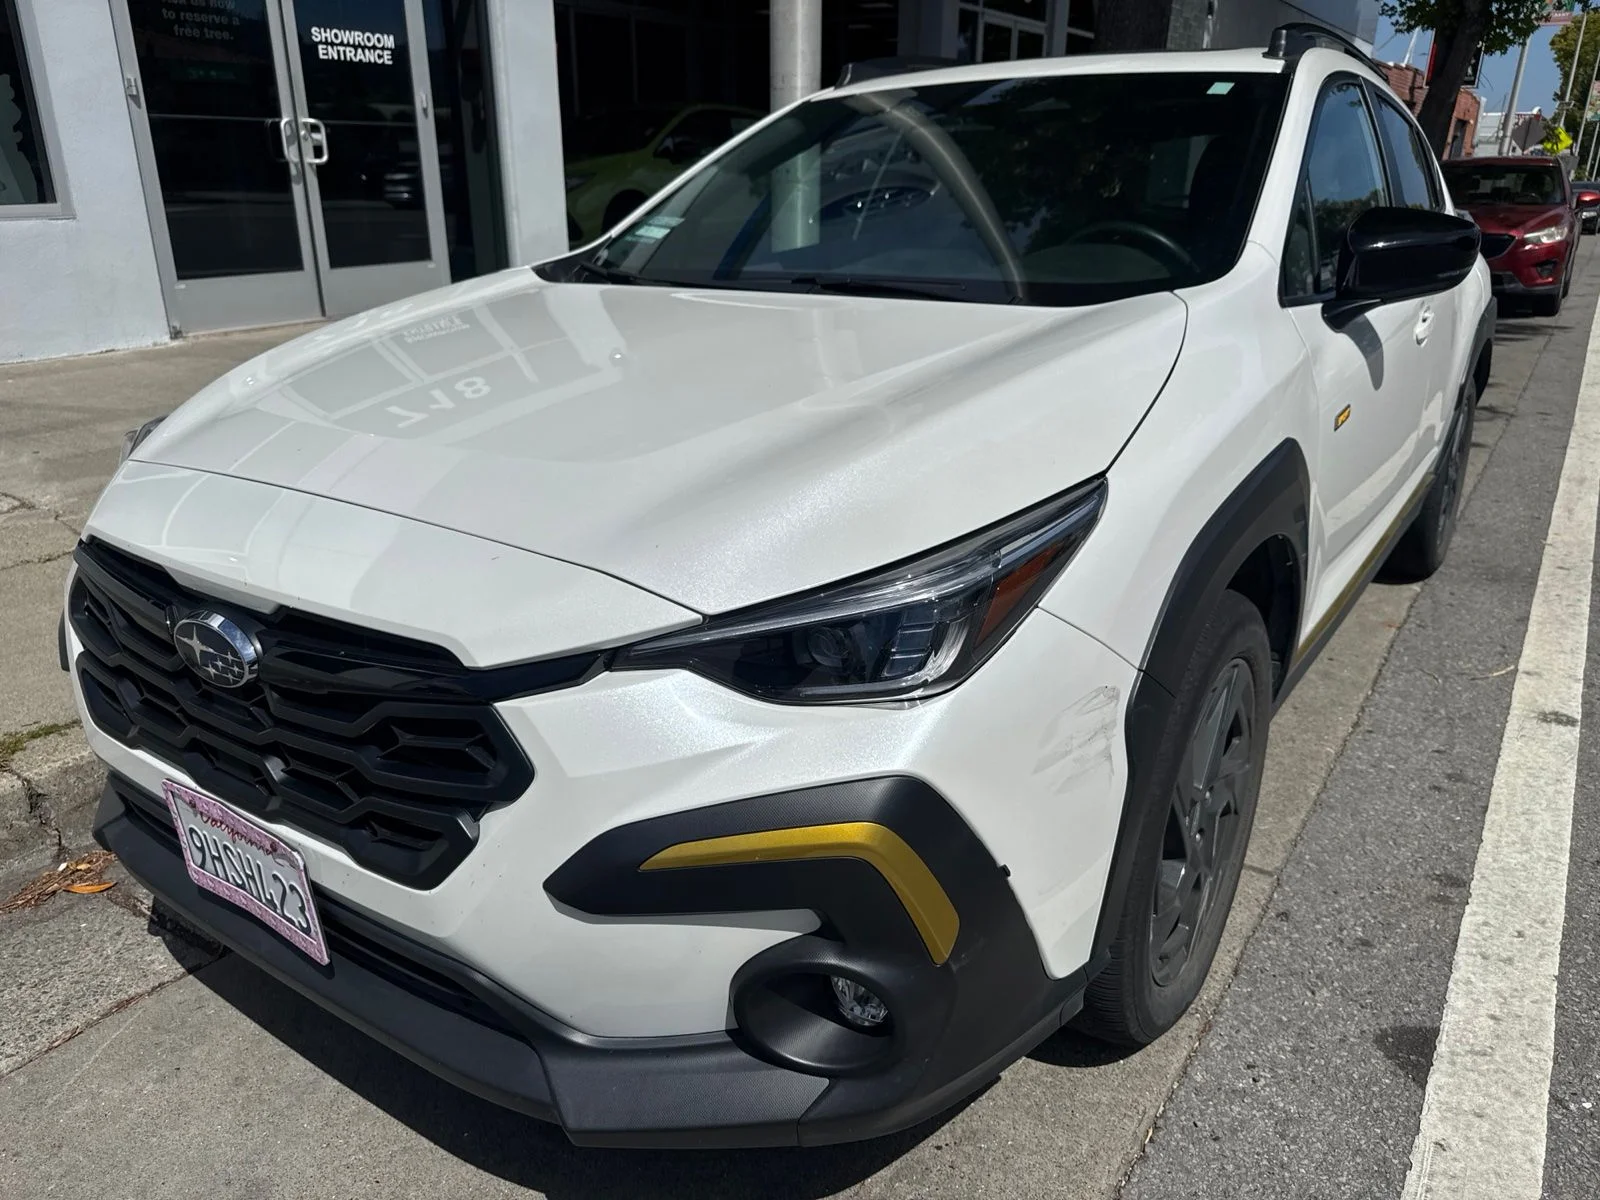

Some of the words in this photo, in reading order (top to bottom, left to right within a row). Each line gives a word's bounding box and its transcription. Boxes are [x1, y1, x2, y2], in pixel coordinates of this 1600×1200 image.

[161, 8, 176, 20] to
[180, 11, 229, 25] reserve
[232, 17, 240, 26] a
[172, 24, 200, 38] free
[203, 27, 234, 40] tree.
[311, 26, 395, 49] SHOWROOM
[318, 44, 393, 65] ENTRANCE
[188, 824, 312, 935] 9HSH423
